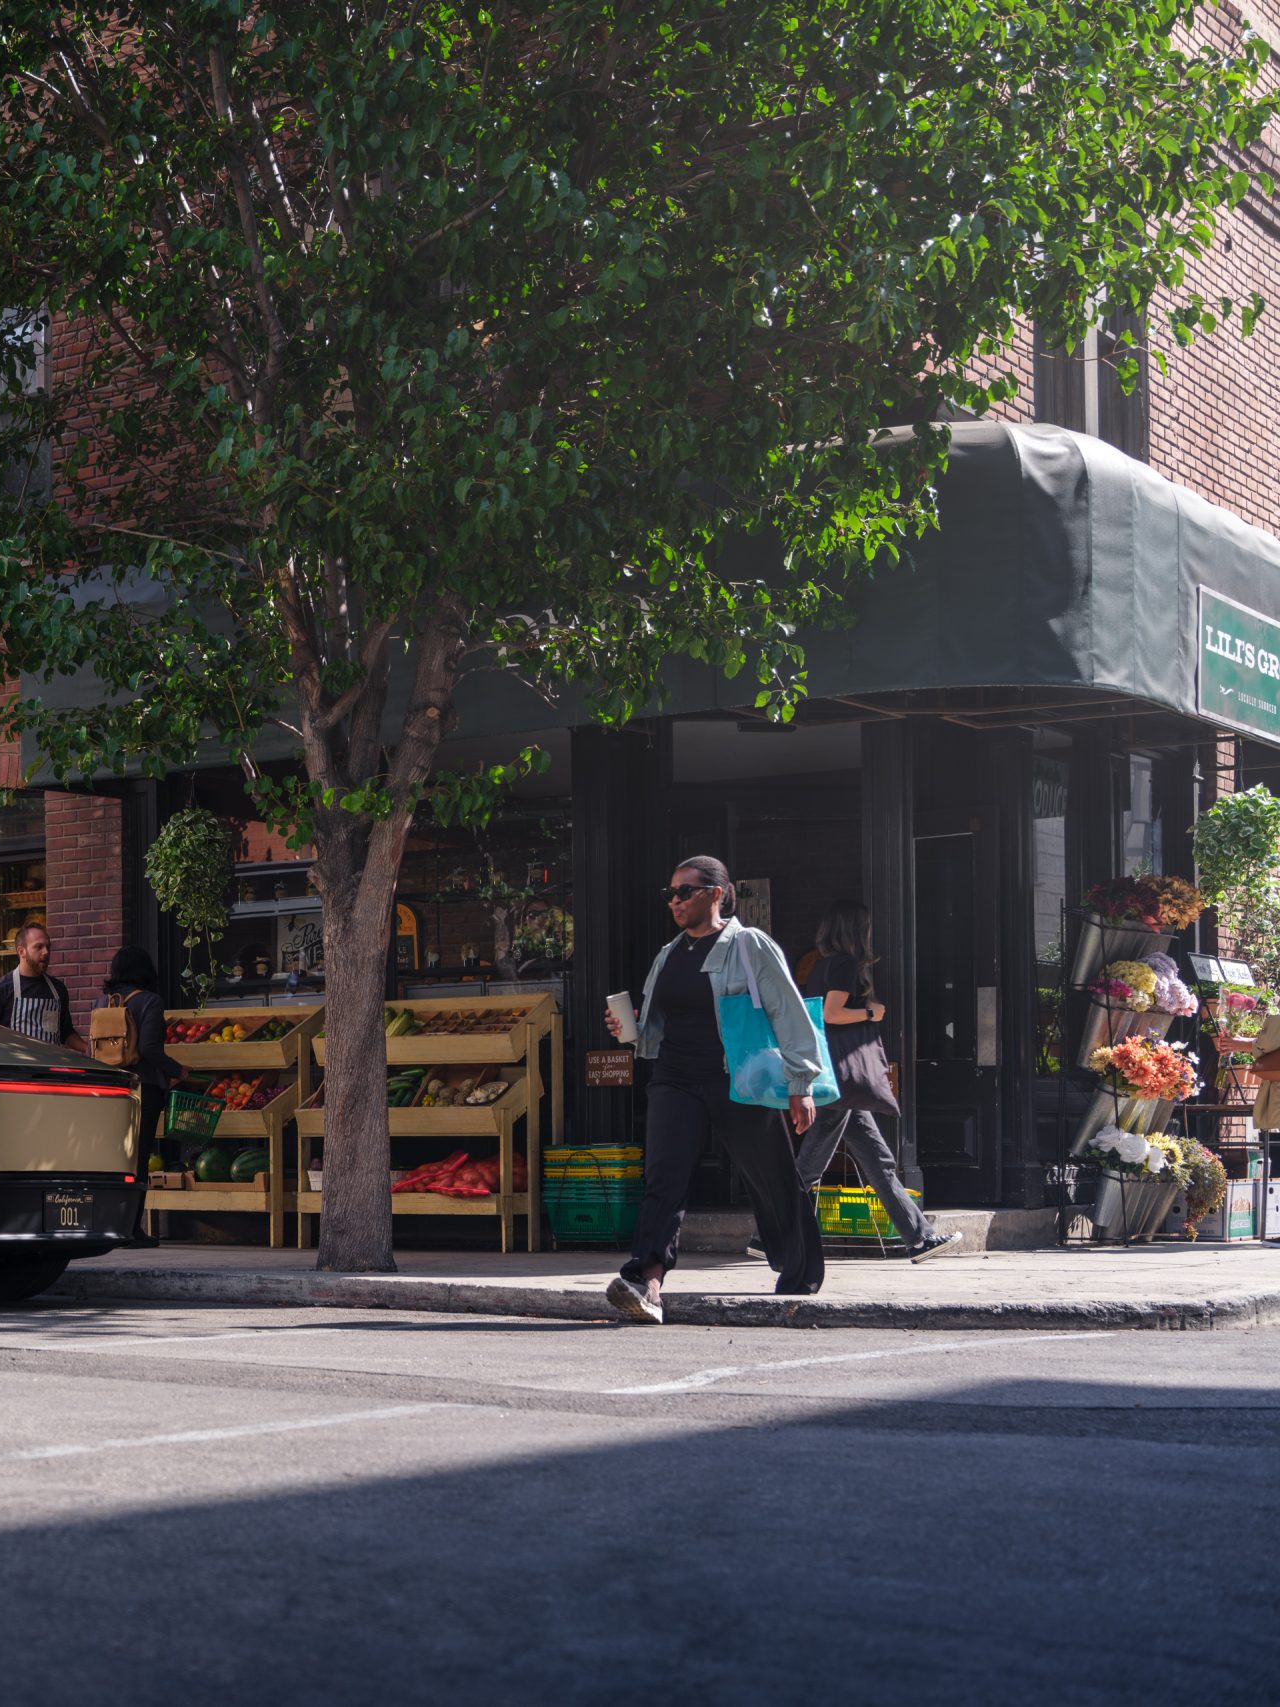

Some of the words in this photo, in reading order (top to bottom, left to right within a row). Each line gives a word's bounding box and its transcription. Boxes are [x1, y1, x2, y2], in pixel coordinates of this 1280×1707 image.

[1205, 625, 1255, 669] LILI'S
[588, 1056, 600, 1064] USE
[607, 1055, 629, 1063] BASKET
[588, 1070, 601, 1079] EASY
[602, 1070, 630, 1079] SHOPPING
[54, 1193, 84, 1206] California
[60, 1207, 79, 1226] 001
